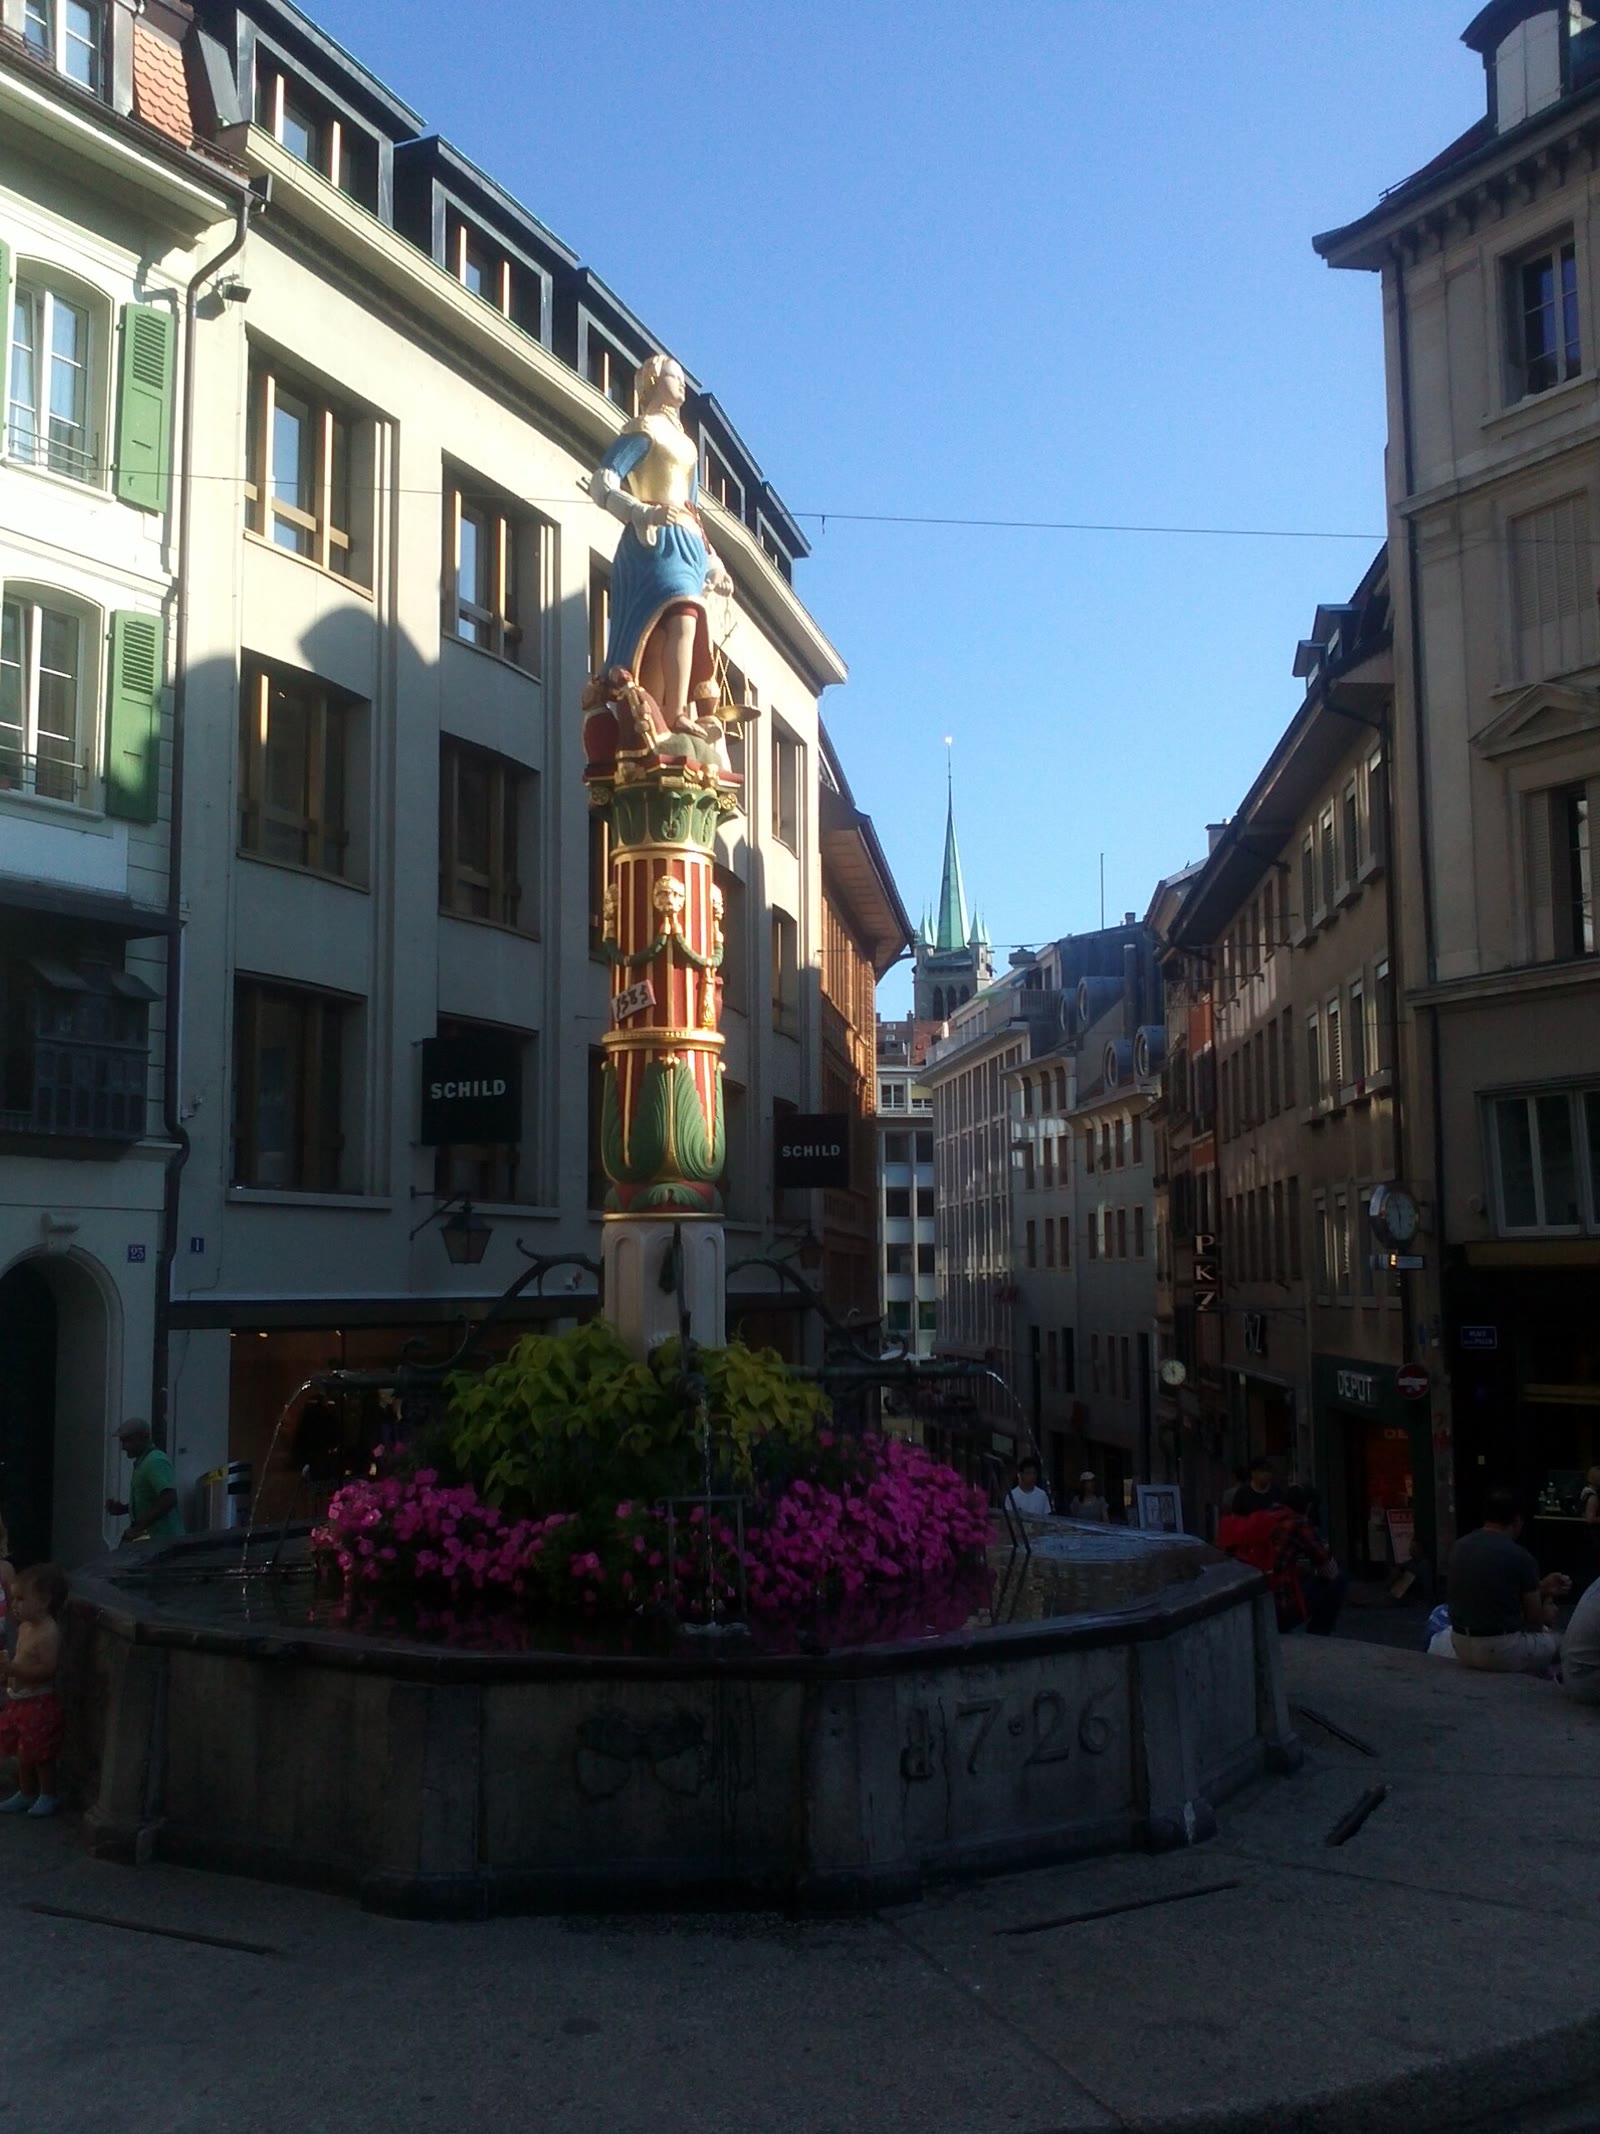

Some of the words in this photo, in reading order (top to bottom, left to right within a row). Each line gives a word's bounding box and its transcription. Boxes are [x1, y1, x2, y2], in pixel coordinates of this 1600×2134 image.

[431, 1079, 506, 1100] SCHILD
[781, 1144, 841, 1158] SCHILD
[1194, 1234, 1216, 1311] PKZ
